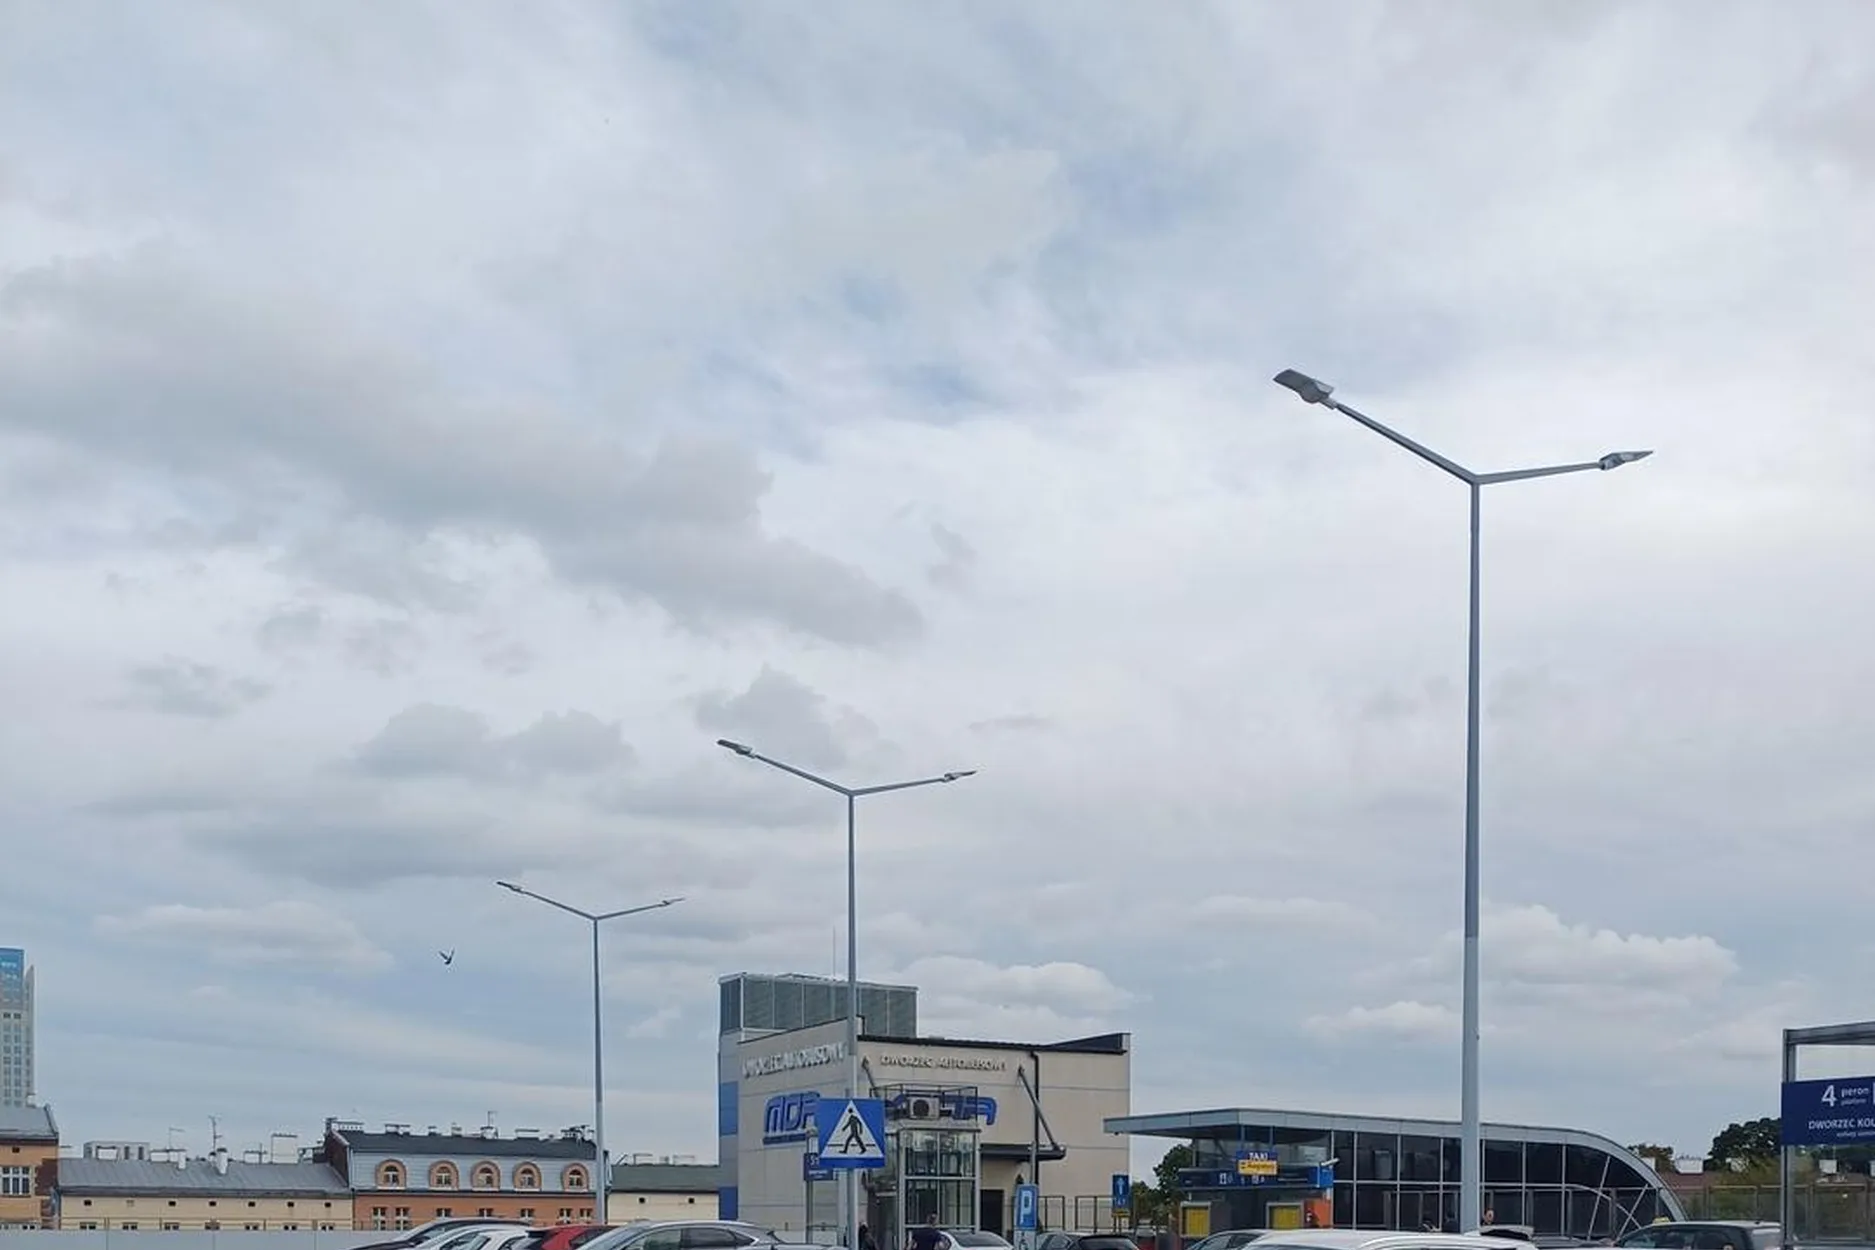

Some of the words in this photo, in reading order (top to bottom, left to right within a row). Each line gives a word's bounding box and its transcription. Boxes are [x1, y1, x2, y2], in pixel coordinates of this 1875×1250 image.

[1821, 1084, 1837, 1107] 4
[1841, 1087, 1869, 1098] peron
[1808, 1118, 1855, 1130] DWORZEC
[1249, 1152, 1269, 1160] TAXI
[1019, 1190, 1032, 1222] P
